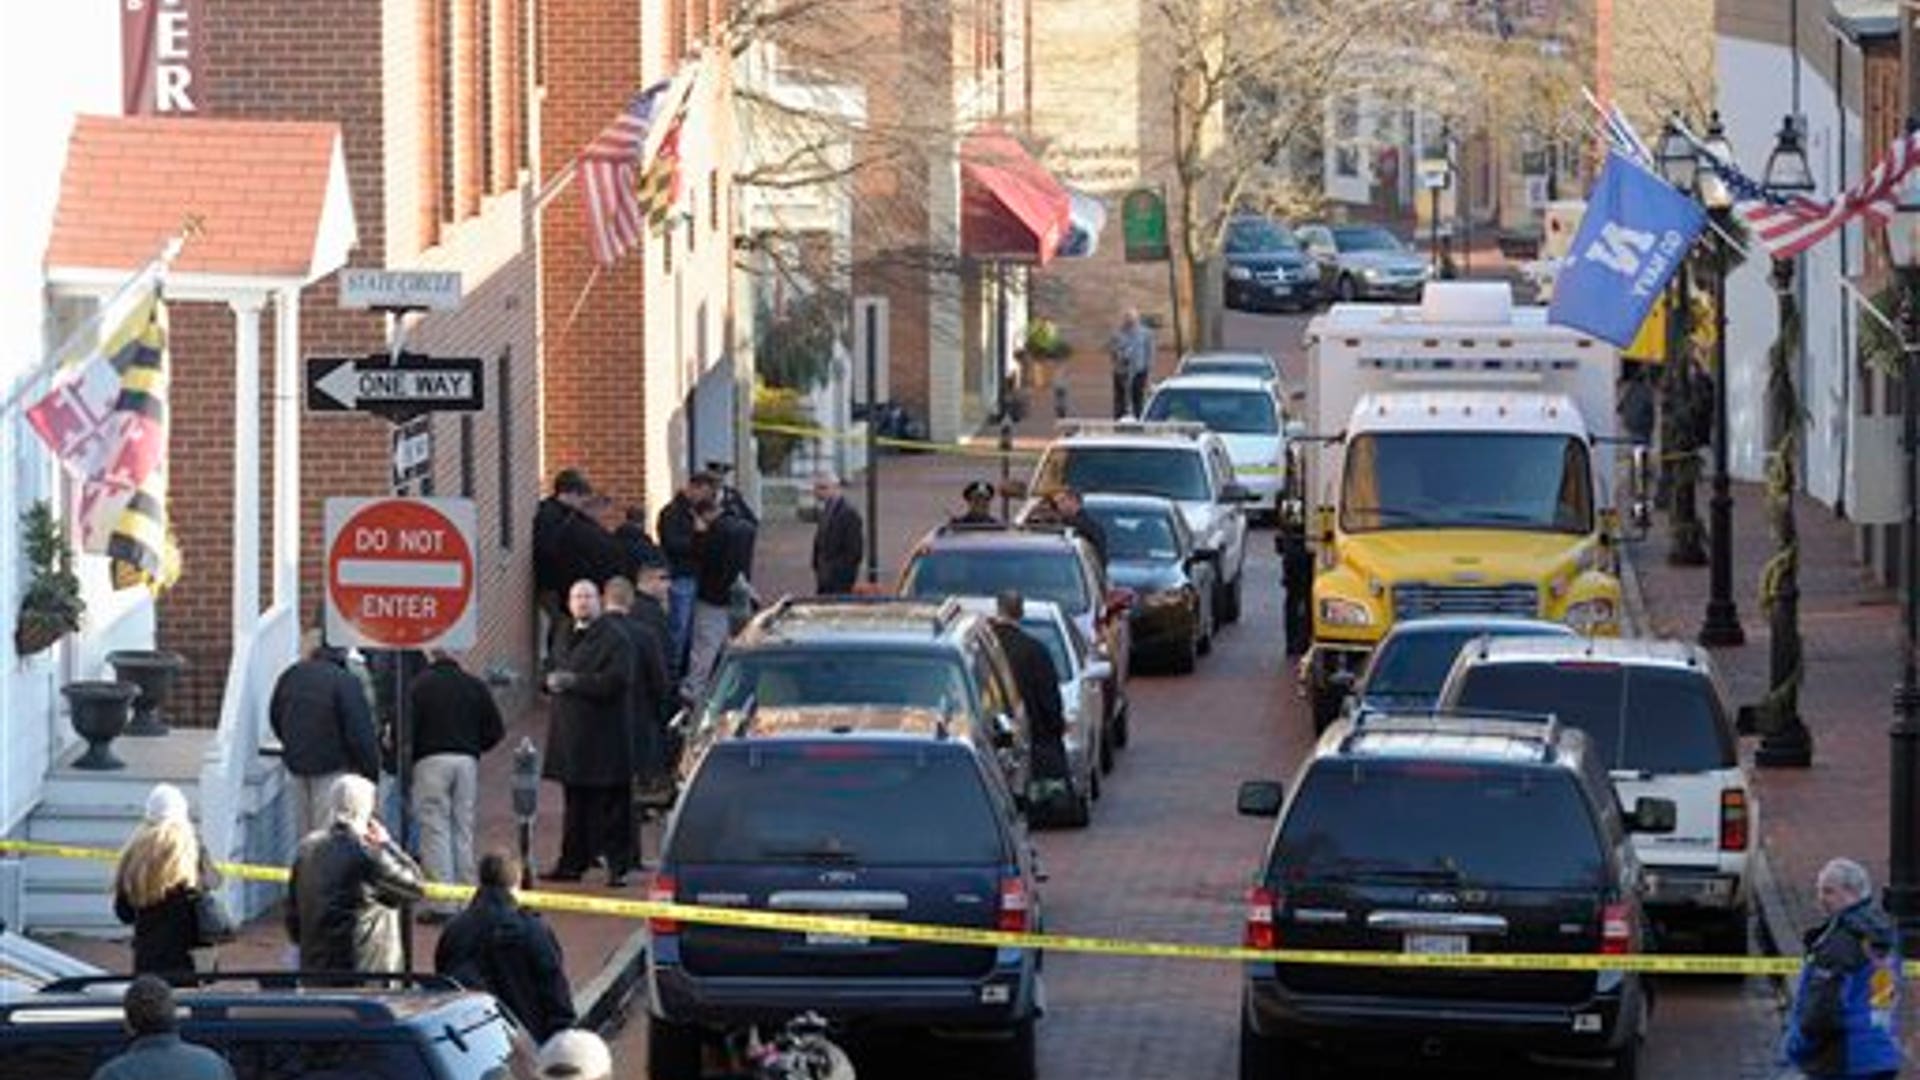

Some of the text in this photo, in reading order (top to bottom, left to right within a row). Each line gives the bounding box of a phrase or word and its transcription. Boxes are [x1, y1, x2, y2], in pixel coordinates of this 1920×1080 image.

[157, 0, 198, 111] ER
[348, 274, 454, 293] STATE CIRCLE
[359, 372, 464, 396] ONE WAY
[355, 527, 446, 554] DO NOT
[362, 593, 437, 619] ENTER
